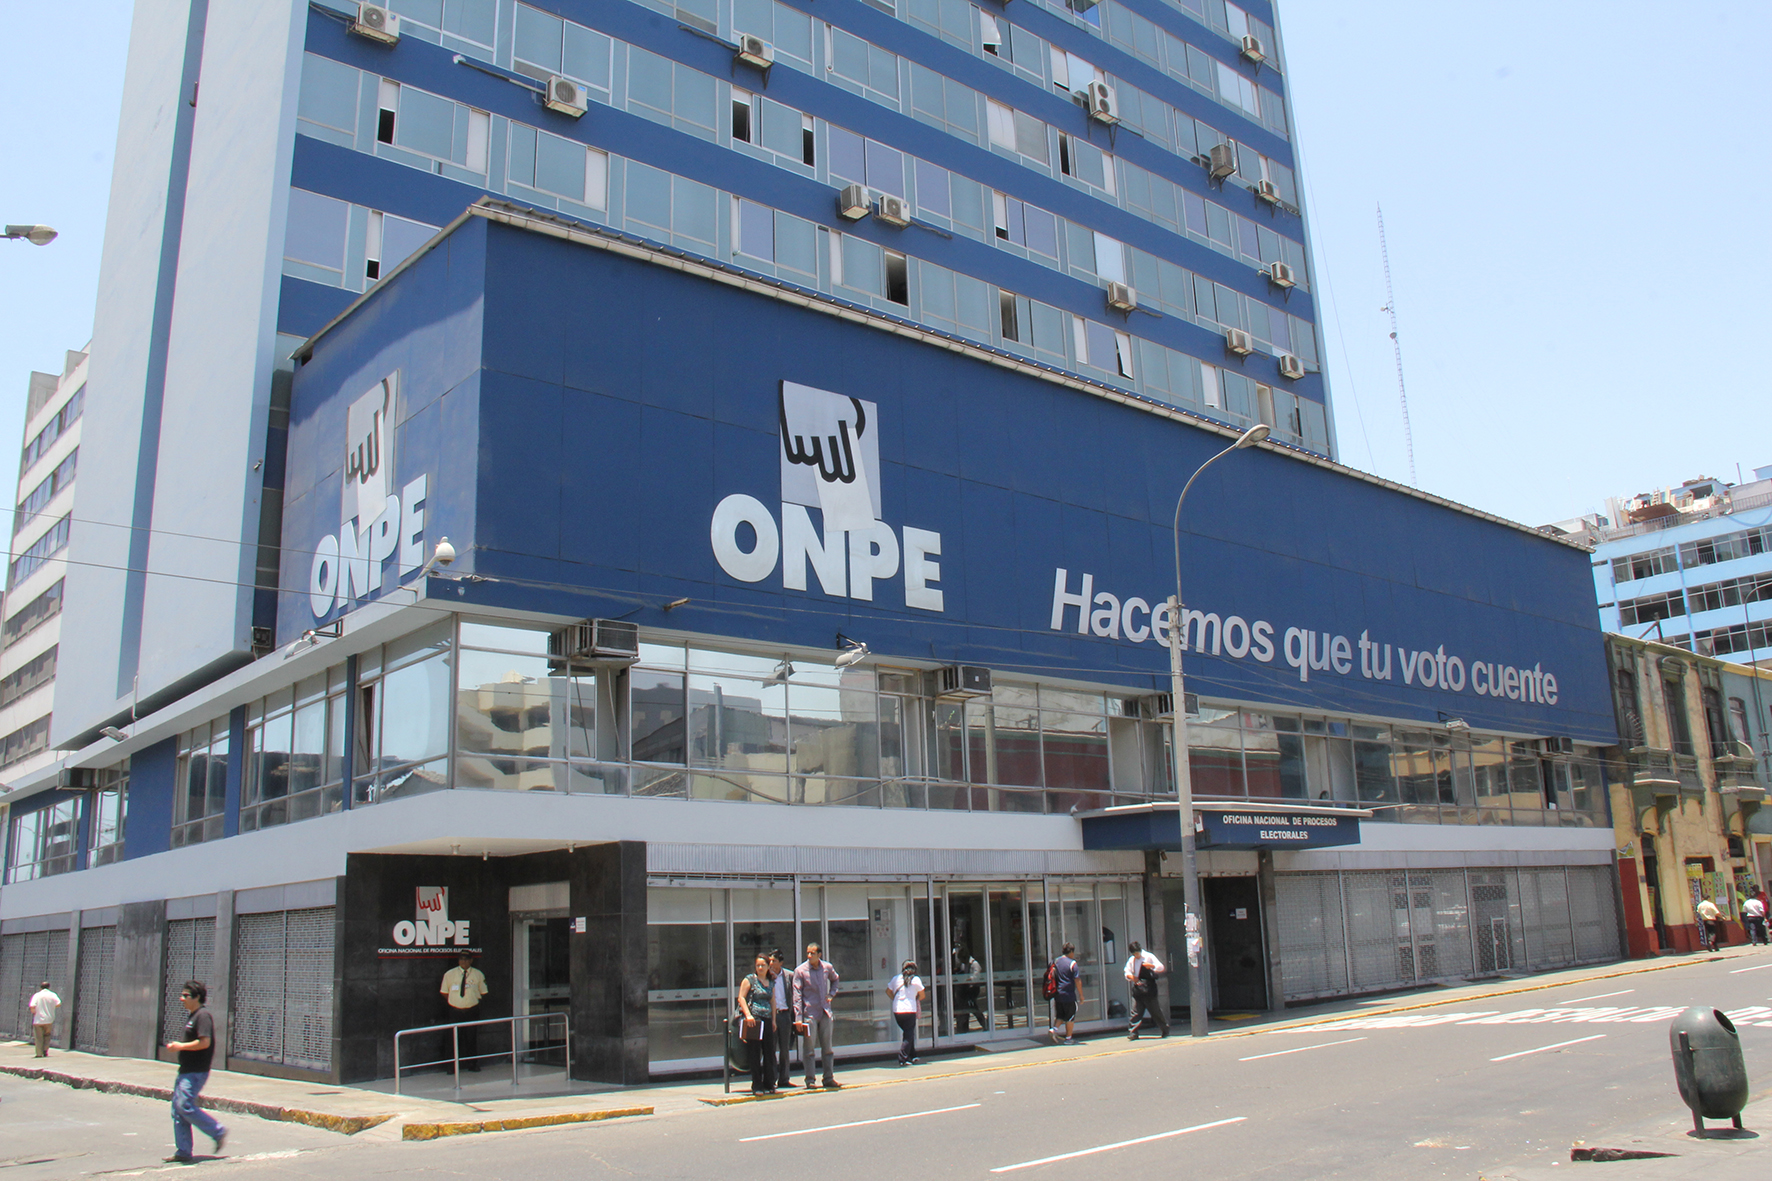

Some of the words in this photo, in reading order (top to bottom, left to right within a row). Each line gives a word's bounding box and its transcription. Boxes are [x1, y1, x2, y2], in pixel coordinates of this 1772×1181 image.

[310, 473, 427, 618] ONPE
[711, 493, 944, 612] ONPE
[1051, 567, 1275, 662] Hacemos
[1284, 626, 1352, 682] que
[1358, 628, 1392, 680] tu
[1398, 644, 1466, 692] voto
[1472, 660, 1558, 705] cuente
[1222, 814, 1253, 825] OFICINA
[1254, 816, 1290, 826] NACIONAL
[1292, 816, 1302, 826] DE
[1303, 817, 1337, 827] PROCESOS
[1260, 830, 1308, 840] ELECTORALES
[393, 920, 470, 946] ONPE
